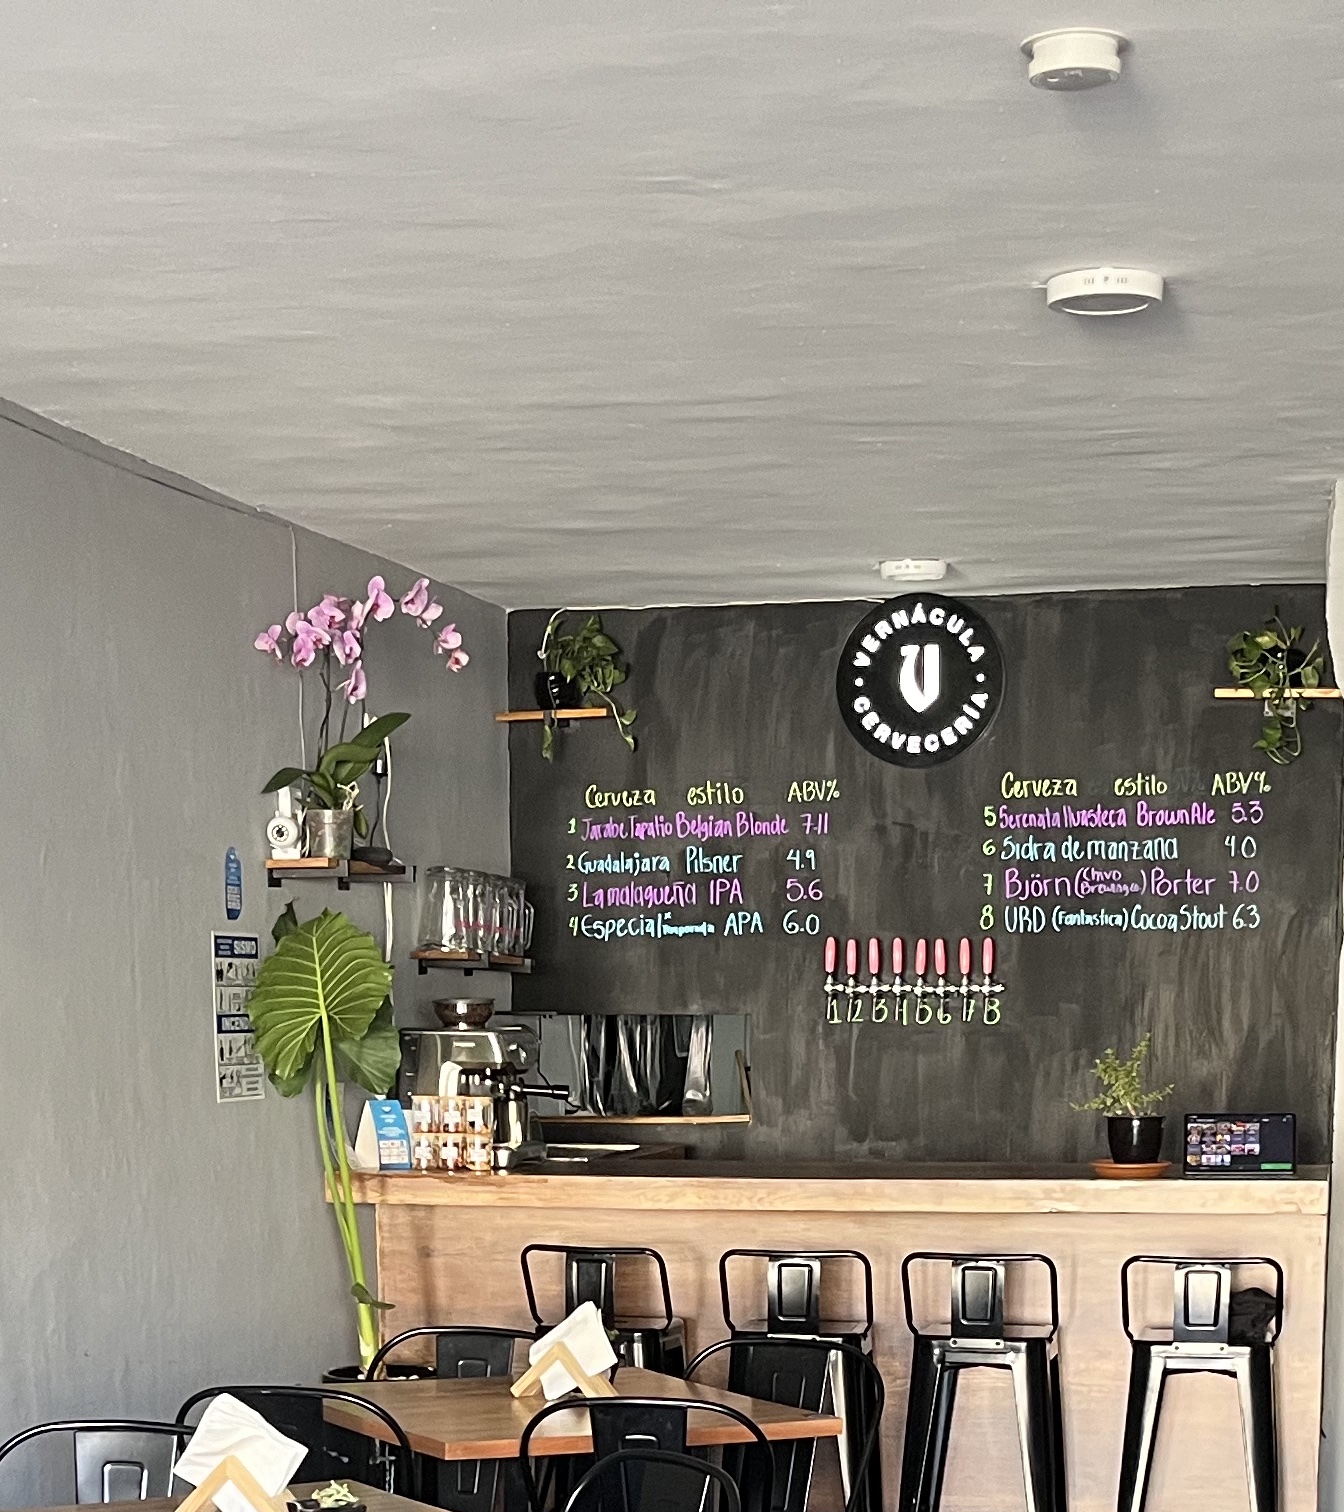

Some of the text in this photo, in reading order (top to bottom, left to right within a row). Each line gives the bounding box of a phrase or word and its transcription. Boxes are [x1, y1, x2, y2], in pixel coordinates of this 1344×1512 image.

[585, 779, 840, 808] Cerveza estilo ABV%
[1001, 771, 1272, 799] Cerveza estilo ABV%
[567, 817, 576, 834] 1
[581, 815, 628, 841] Jarabe
[675, 811, 732, 842] Belgian
[736, 811, 789, 838] Blonde
[983, 805, 997, 827] 5
[999, 804, 1061, 829] Serenata
[1231, 800, 1264, 824] 5.3
[565, 845, 816, 876] 2 Guadalajara Pilsner 4.9
[982, 839, 996, 856] 6
[1000, 834, 1056, 863] Sidra
[1061, 834, 1084, 862] de
[1086, 837, 1178, 862] manzana
[567, 883, 579, 902] 3
[709, 878, 744, 906] IPA
[786, 878, 823, 902] 5.6
[982, 873, 993, 896] 7
[1004, 867, 1071, 901] Björn
[1151, 866, 1216, 897] Porter
[1228, 870, 1260, 894] 7.0
[568, 916, 579, 937] 4
[580, 912, 662, 942] Especial
[723, 911, 764, 937] APA
[782, 909, 820, 935] 6.0
[979, 904, 995, 930] 8
[1130, 903, 1178, 933] Cocoa
[1179, 903, 1228, 931] Stout
[829, 998, 842, 1024] 1
[851, 998, 864, 1022] 2
[872, 998, 888, 1023] 3
[936, 1002, 952, 1025] 6
[983, 997, 1001, 1025] 8
